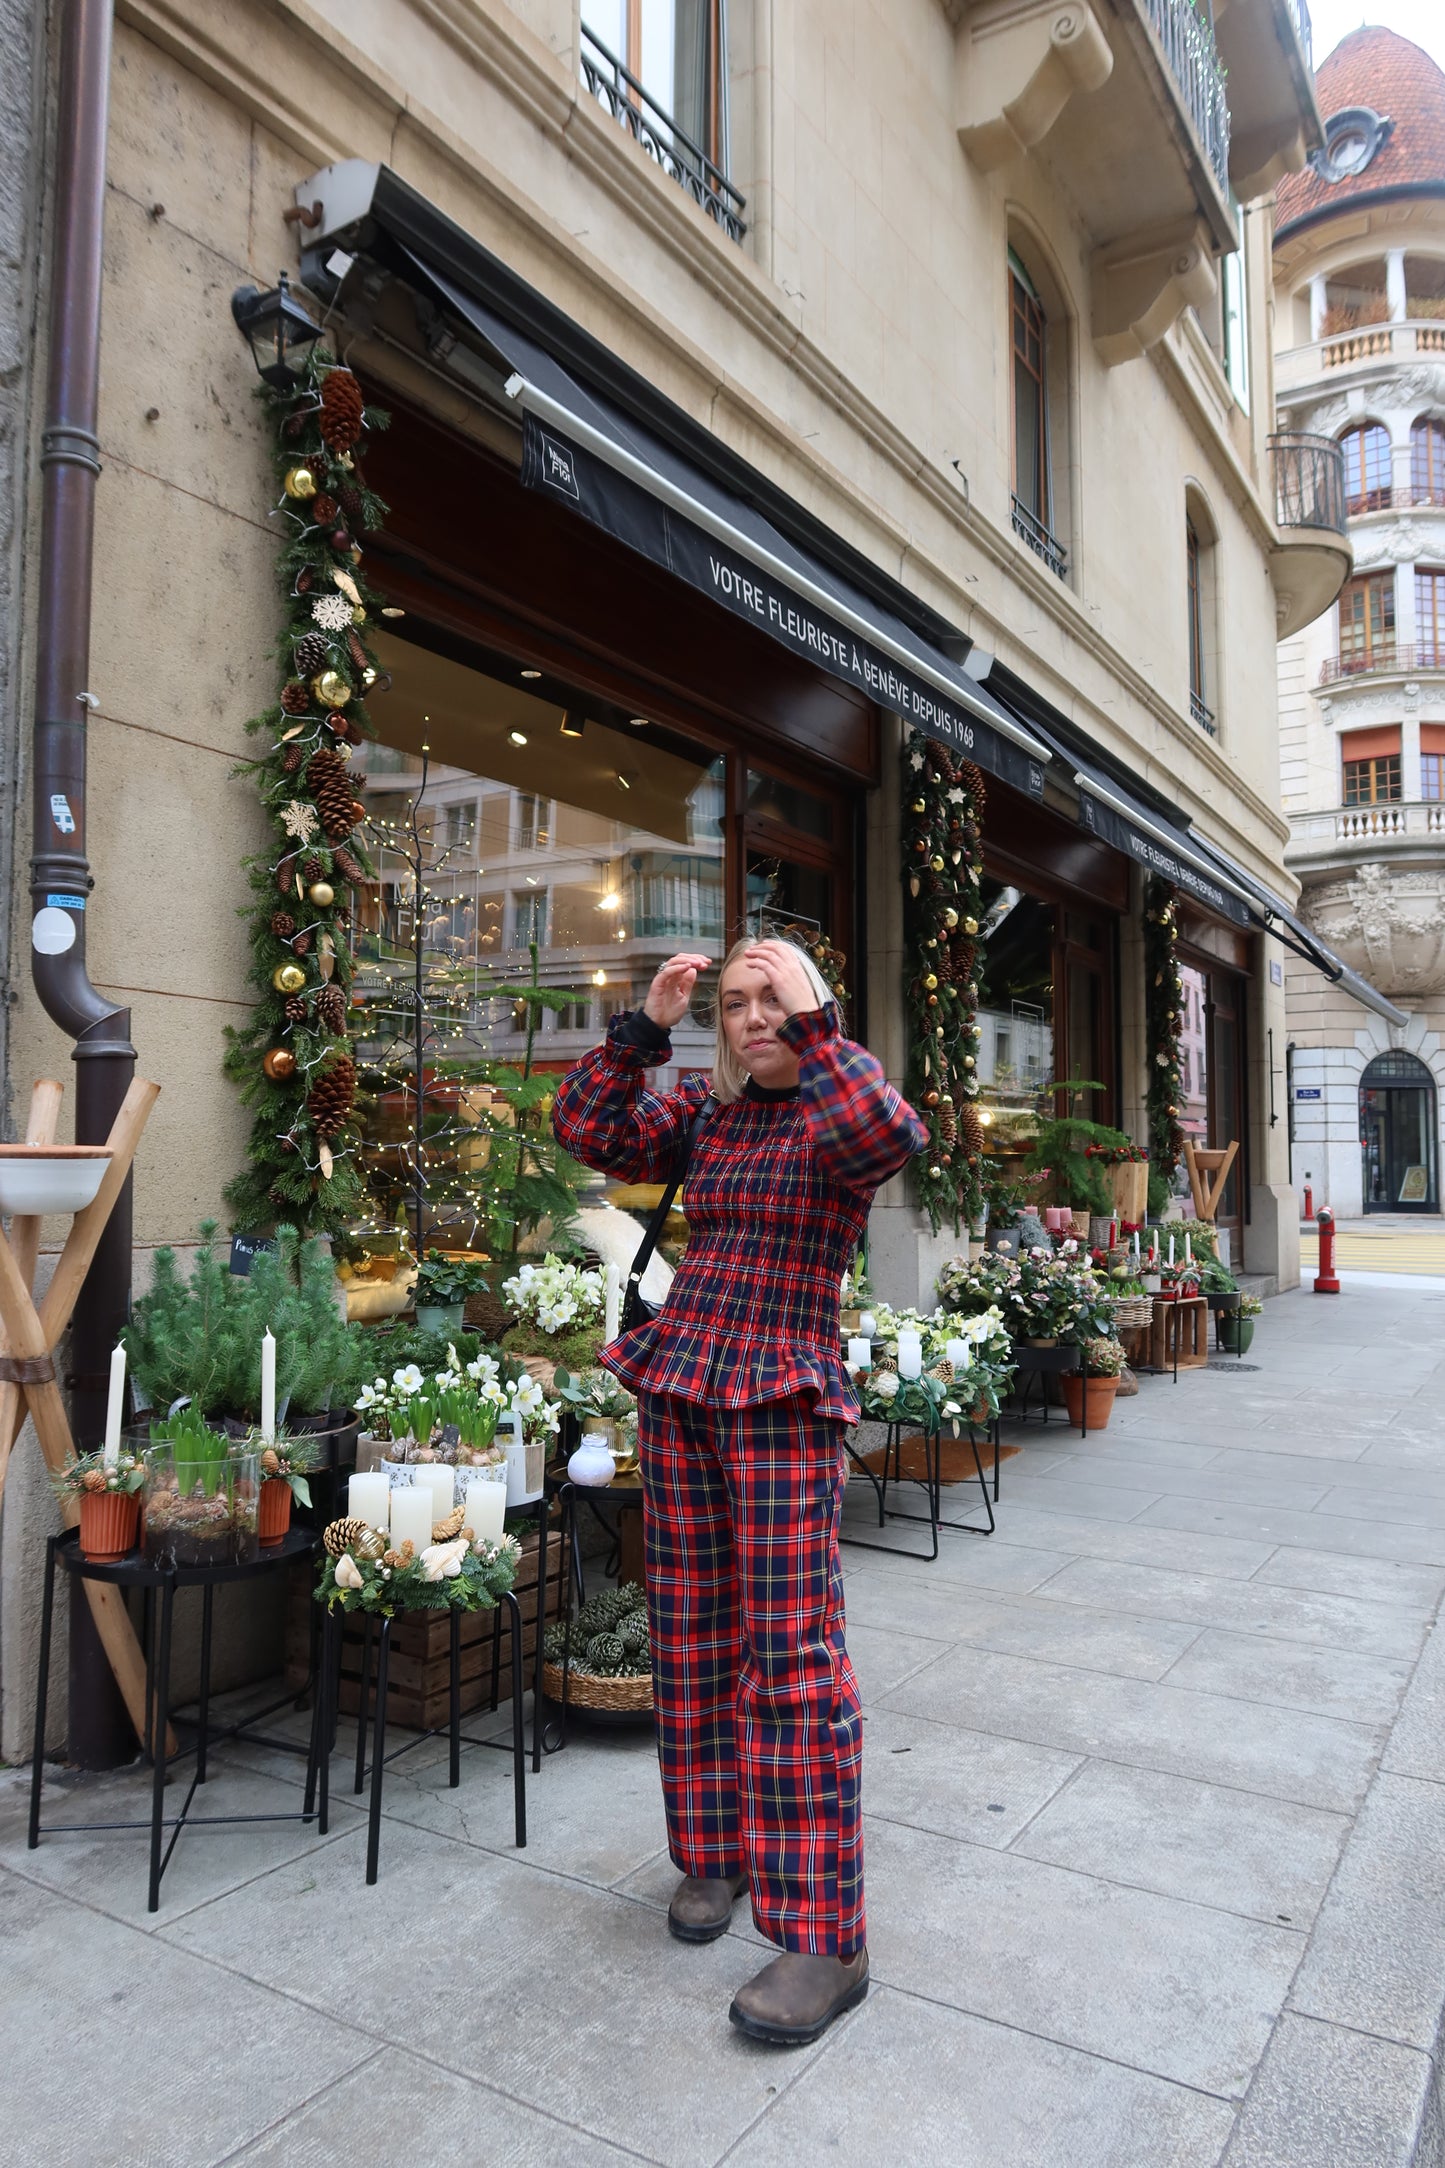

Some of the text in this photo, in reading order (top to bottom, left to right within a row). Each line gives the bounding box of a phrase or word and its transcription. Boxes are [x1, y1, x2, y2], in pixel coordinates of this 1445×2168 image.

[551, 460, 572, 484] Flor
[709, 555, 974, 749] VOTRE FLEURISTE À GENÈVE DEPUIS 1968
[393, 879, 443, 915] Mna
[362, 976, 388, 989] VOTRE
[389, 981, 432, 996] FLEURIT
